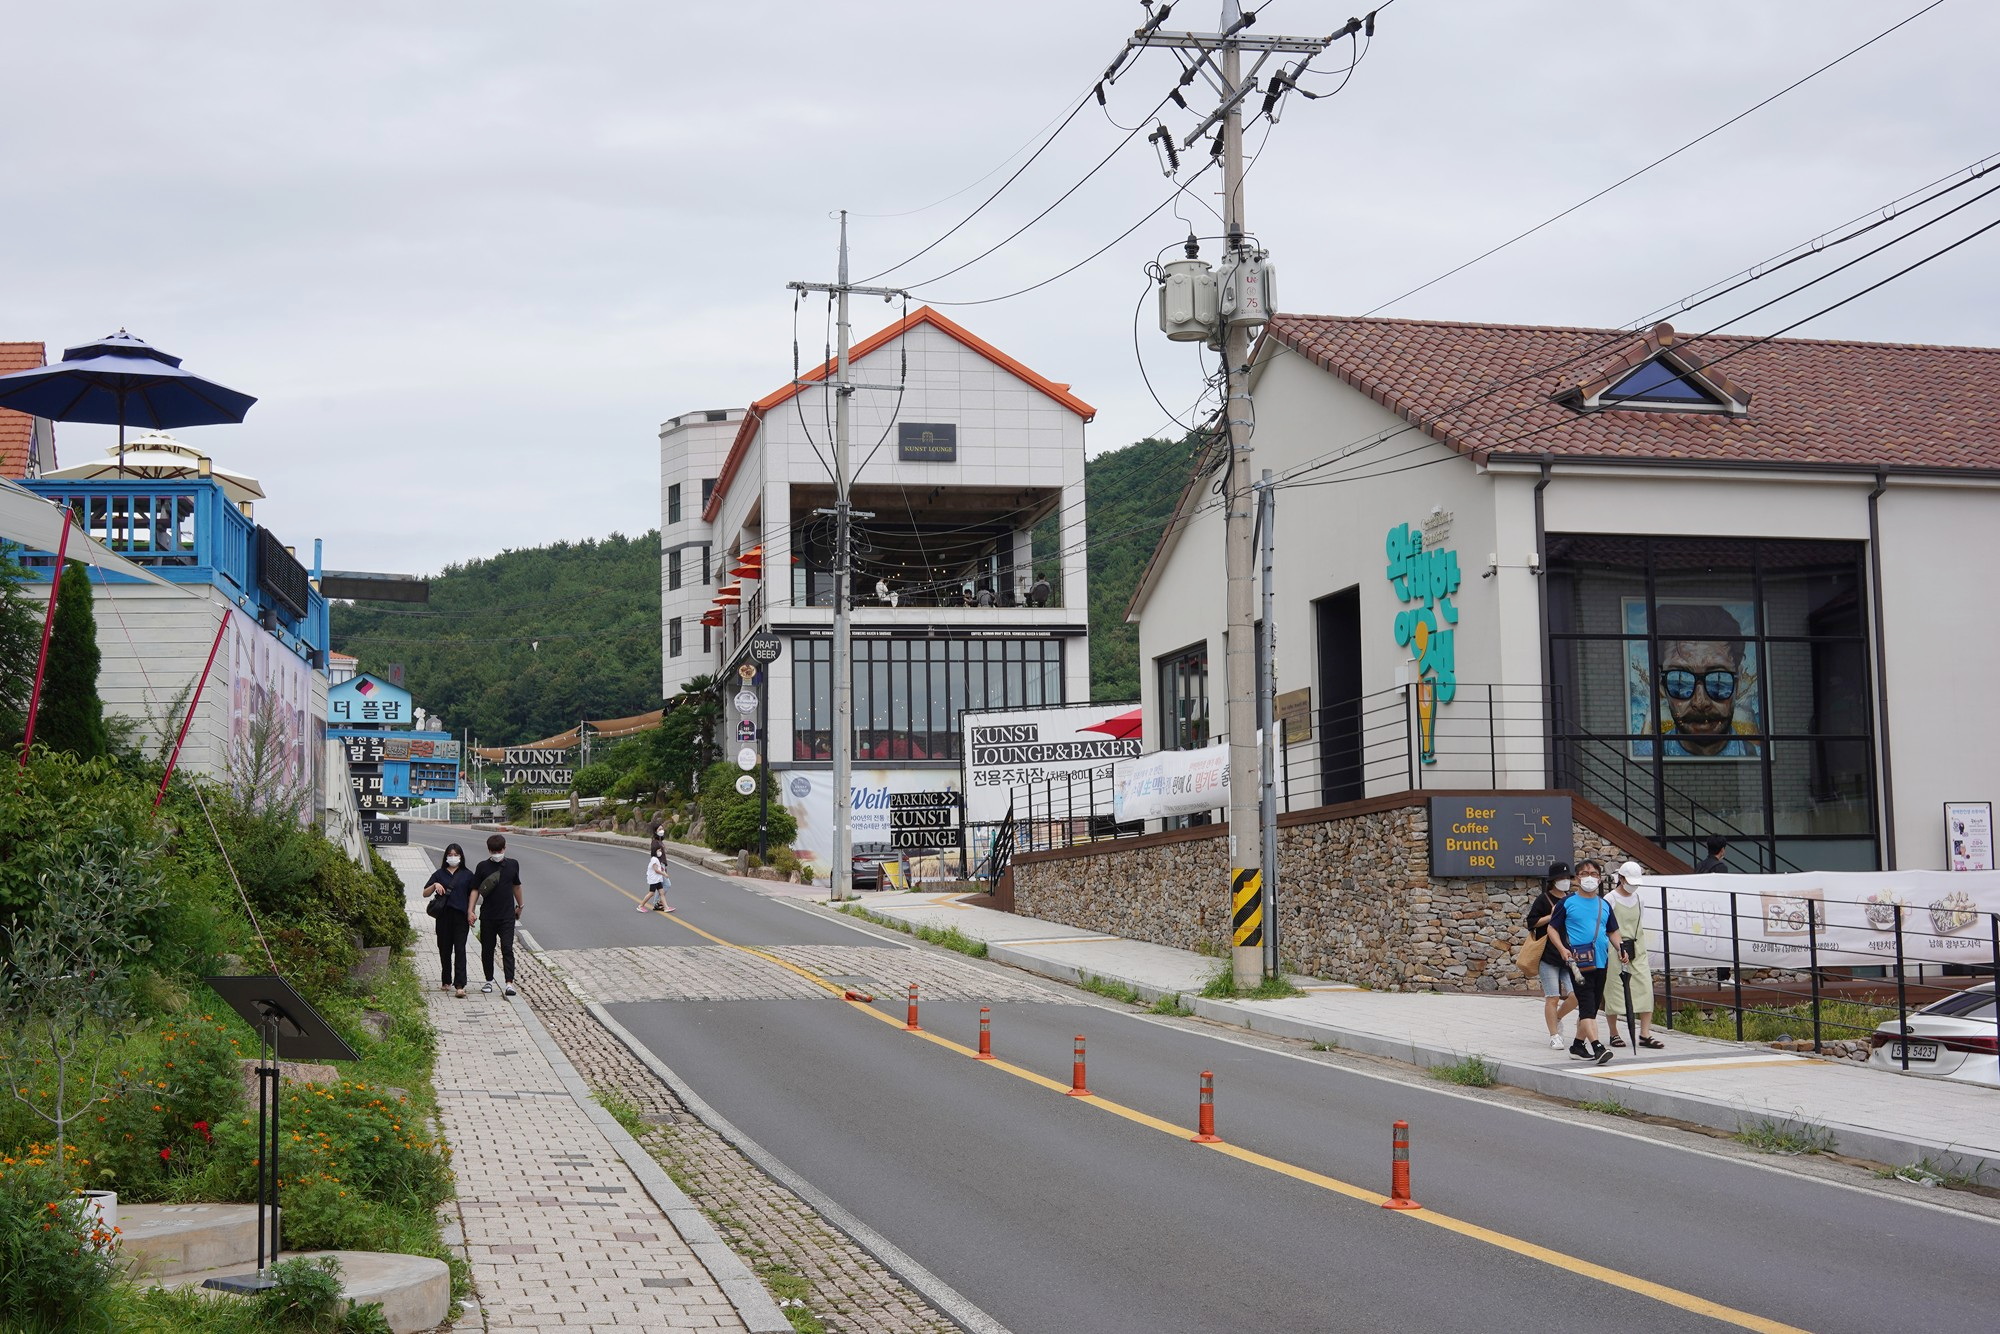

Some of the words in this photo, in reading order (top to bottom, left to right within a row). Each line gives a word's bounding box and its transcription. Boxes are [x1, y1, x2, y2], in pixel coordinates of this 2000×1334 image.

[754, 640, 779, 649] DRAFT
[756, 650, 776, 659] BEER
[333, 700, 351, 720] 더
[361, 700, 401, 720] 플람
[973, 725, 1037, 744] KUNST
[504, 749, 566, 765] KUNST
[973, 740, 1142, 765] LOUNGE&BAKERY
[504, 769, 573, 784] LOUNGE
[890, 793, 938, 807] PARKING
[891, 810, 947, 827] KUNST
[1466, 807, 1496, 819] Beer
[379, 822, 401, 834] 펜션
[1452, 823, 1489, 834] Coffee
[891, 831, 957, 847] LOUNGE
[1446, 837, 1499, 851] Brunch
[1469, 855, 1496, 869] BBQ
[1514, 854, 1556, 867] 매장입구
[1913, 1046, 1932, 1058] 5423
